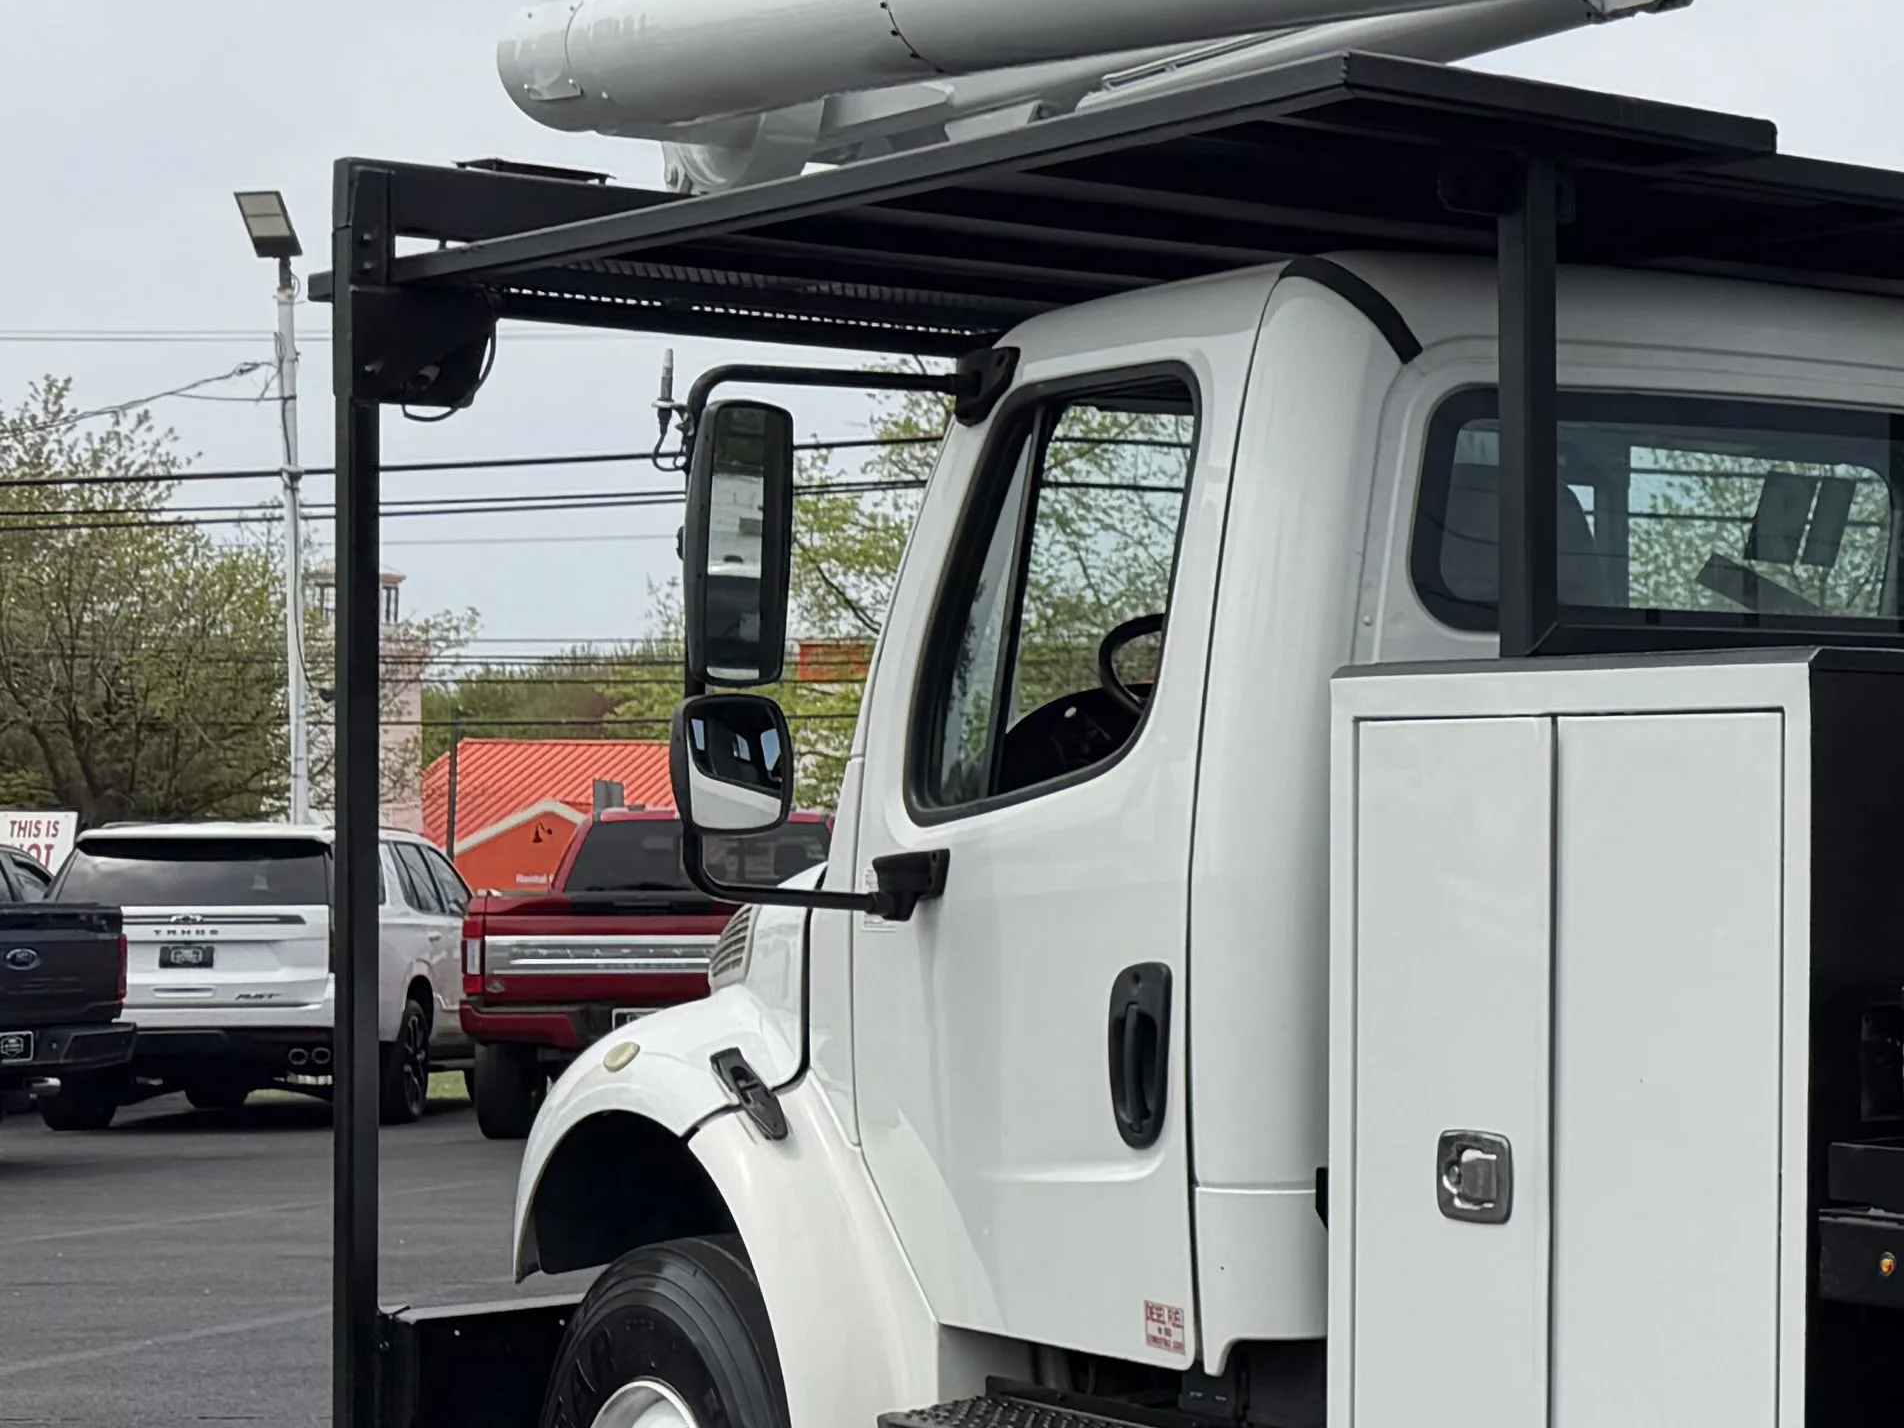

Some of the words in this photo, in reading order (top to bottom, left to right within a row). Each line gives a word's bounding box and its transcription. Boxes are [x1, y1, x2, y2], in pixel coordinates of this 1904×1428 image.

[9, 819, 42, 839] THIS
[45, 819, 60, 839] IS
[19, 842, 55, 869] OT
